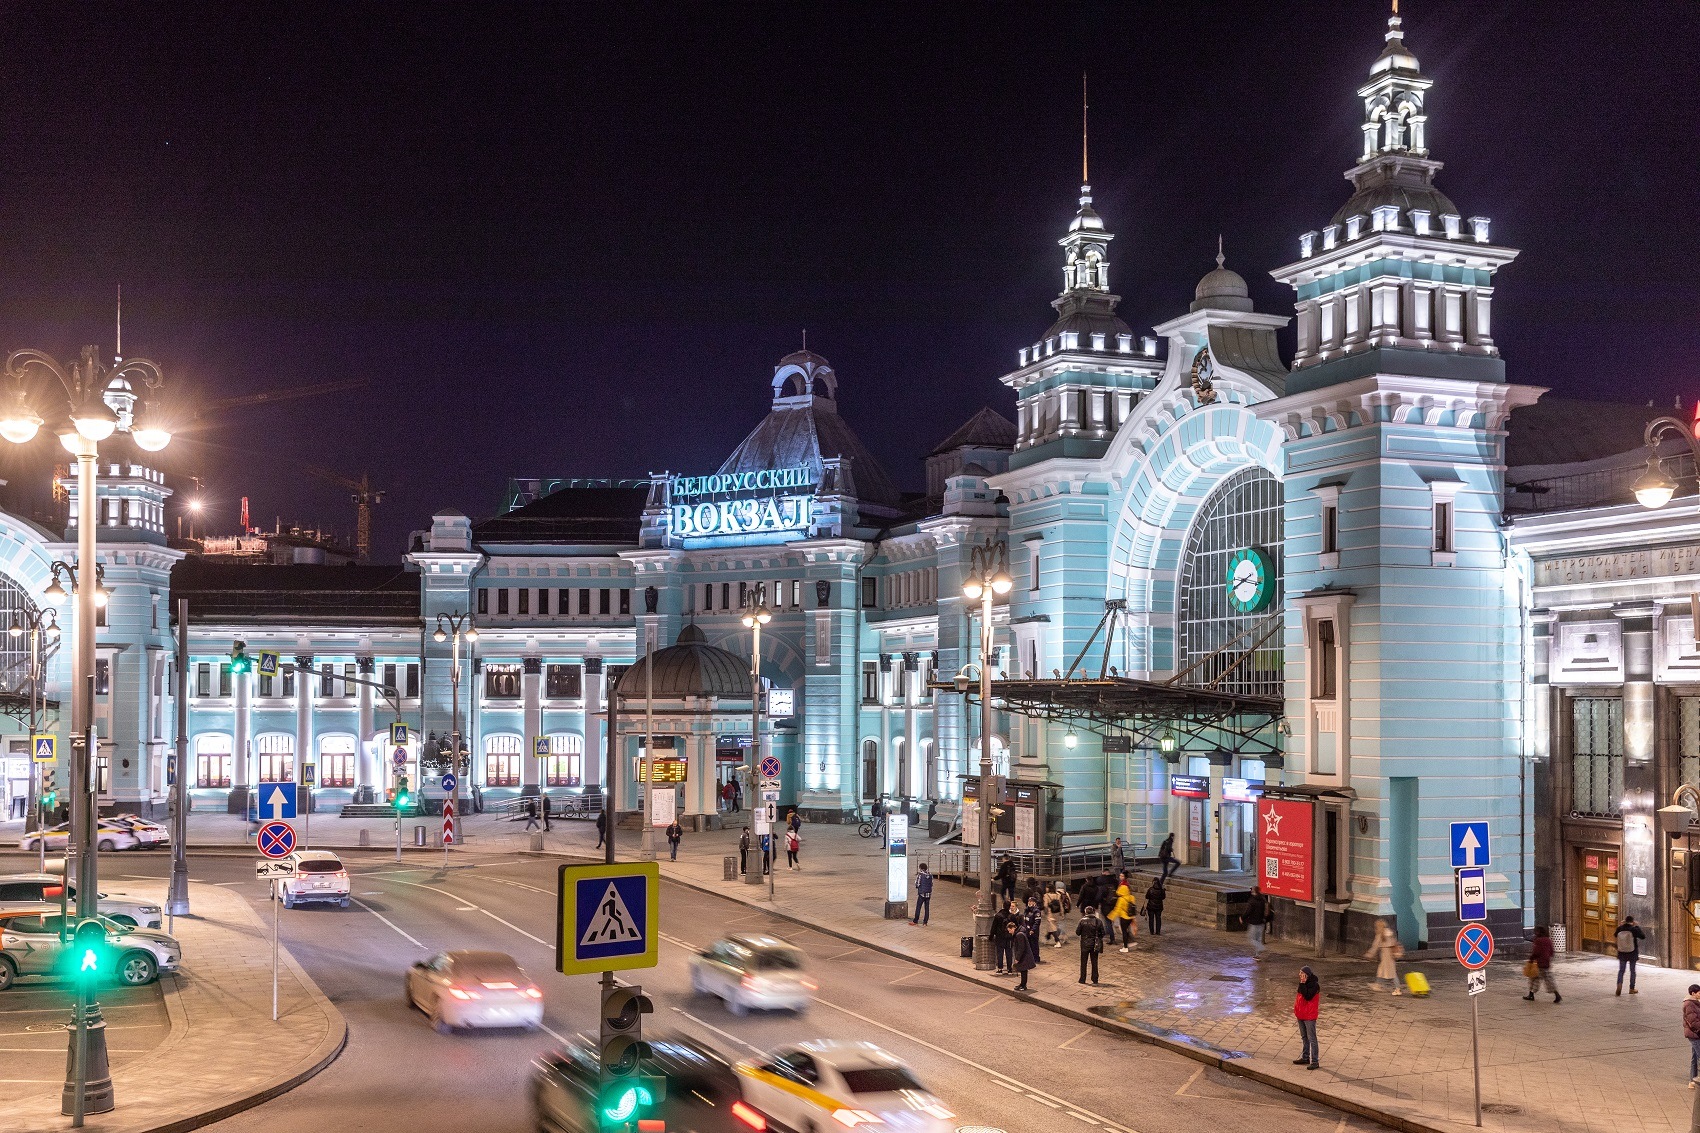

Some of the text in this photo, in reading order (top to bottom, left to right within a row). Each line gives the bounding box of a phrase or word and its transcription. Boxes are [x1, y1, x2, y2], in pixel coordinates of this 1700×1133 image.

[672, 462, 812, 496] БЕЛОРУССКИЙ
[671, 495, 813, 535] ВОКЗАЛ
[1545, 554, 1646, 571] МЕТРОПОЛИТЕН
[1566, 566, 1649, 581] СТАНЦИЯ
